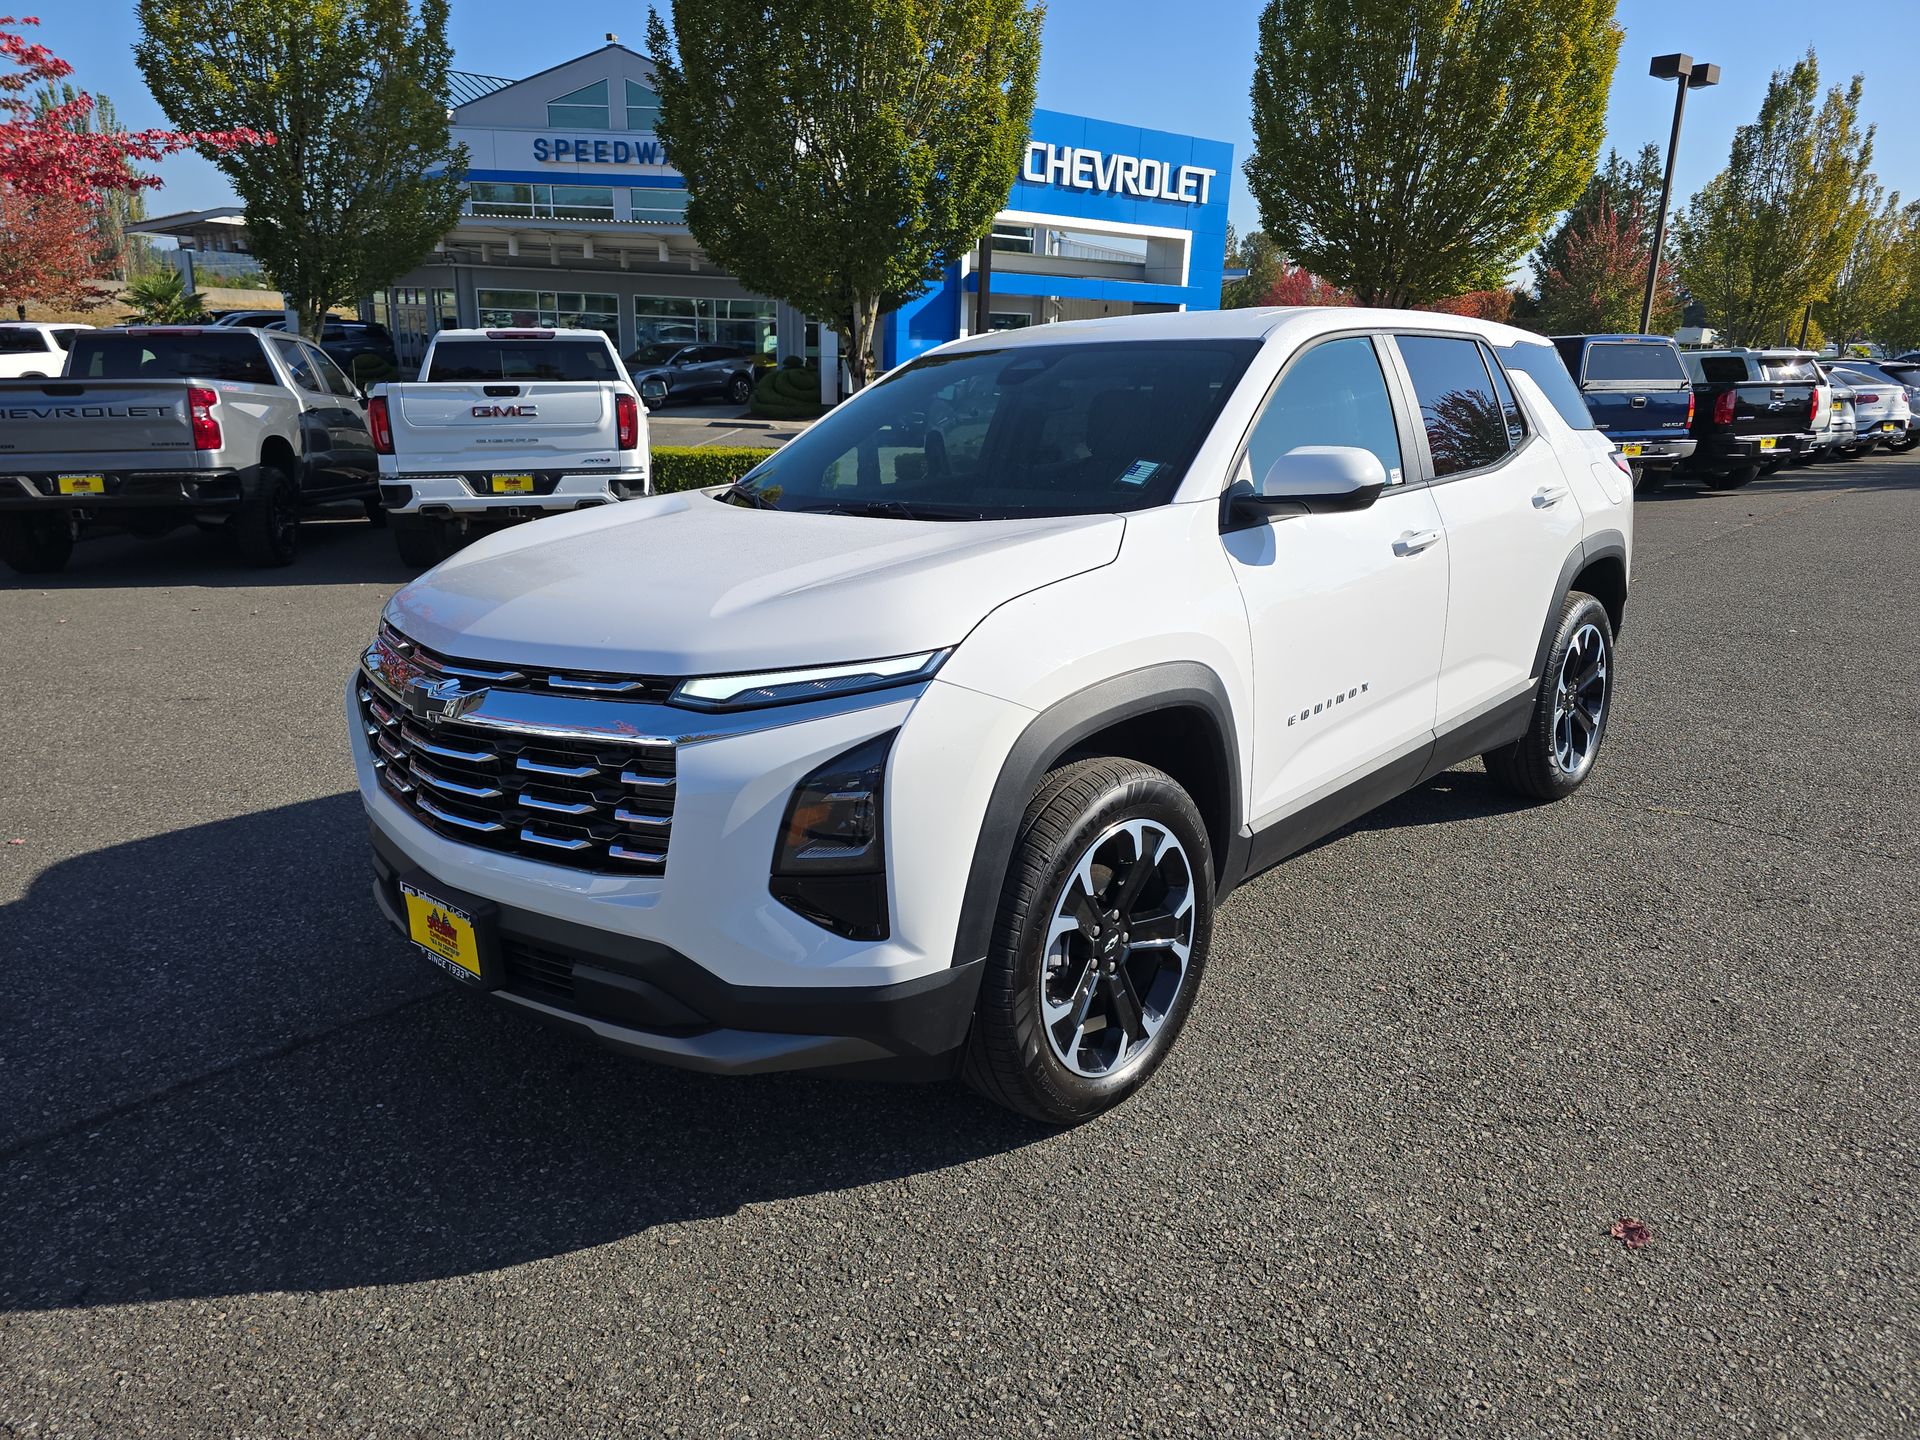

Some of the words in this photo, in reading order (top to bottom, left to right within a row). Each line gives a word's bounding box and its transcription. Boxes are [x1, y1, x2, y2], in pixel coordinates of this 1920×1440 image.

[1023, 141, 1216, 204] CHEVROLET
[472, 405, 538, 418] GMC
[1287, 683, 1369, 727] EQUINOX
[427, 951, 447, 969] SINCE
[448, 964, 465, 979] 1933
